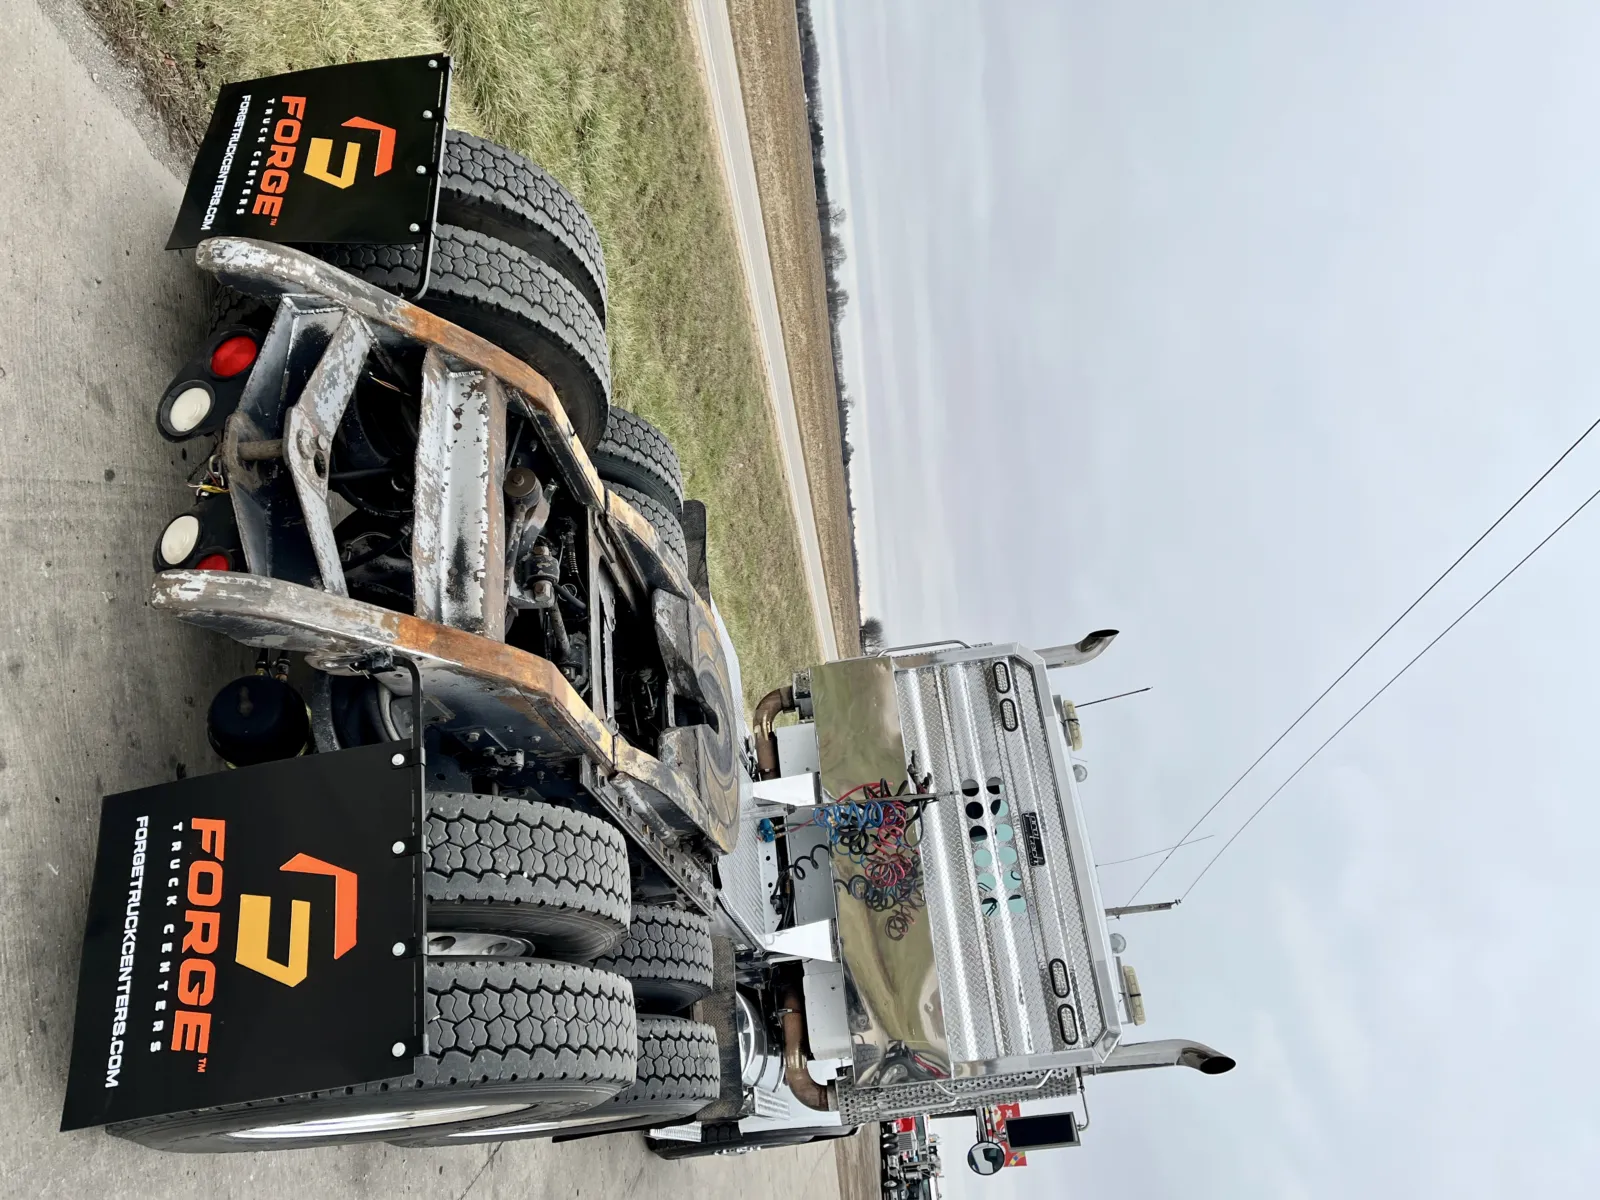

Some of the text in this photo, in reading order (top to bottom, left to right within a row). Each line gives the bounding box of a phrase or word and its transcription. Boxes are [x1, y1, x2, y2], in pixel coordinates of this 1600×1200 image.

[200, 95, 251, 231] FORGETRUCKCENTERS.COM
[235, 98, 275, 215] TRUCK CENTERS
[252, 96, 306, 218] FORGE
[104, 815, 149, 1089] FORGETRUCKCENTERS.COM
[149, 821, 183, 1053] TRUCK CENTERS
[170, 817, 226, 1054] FORGE
